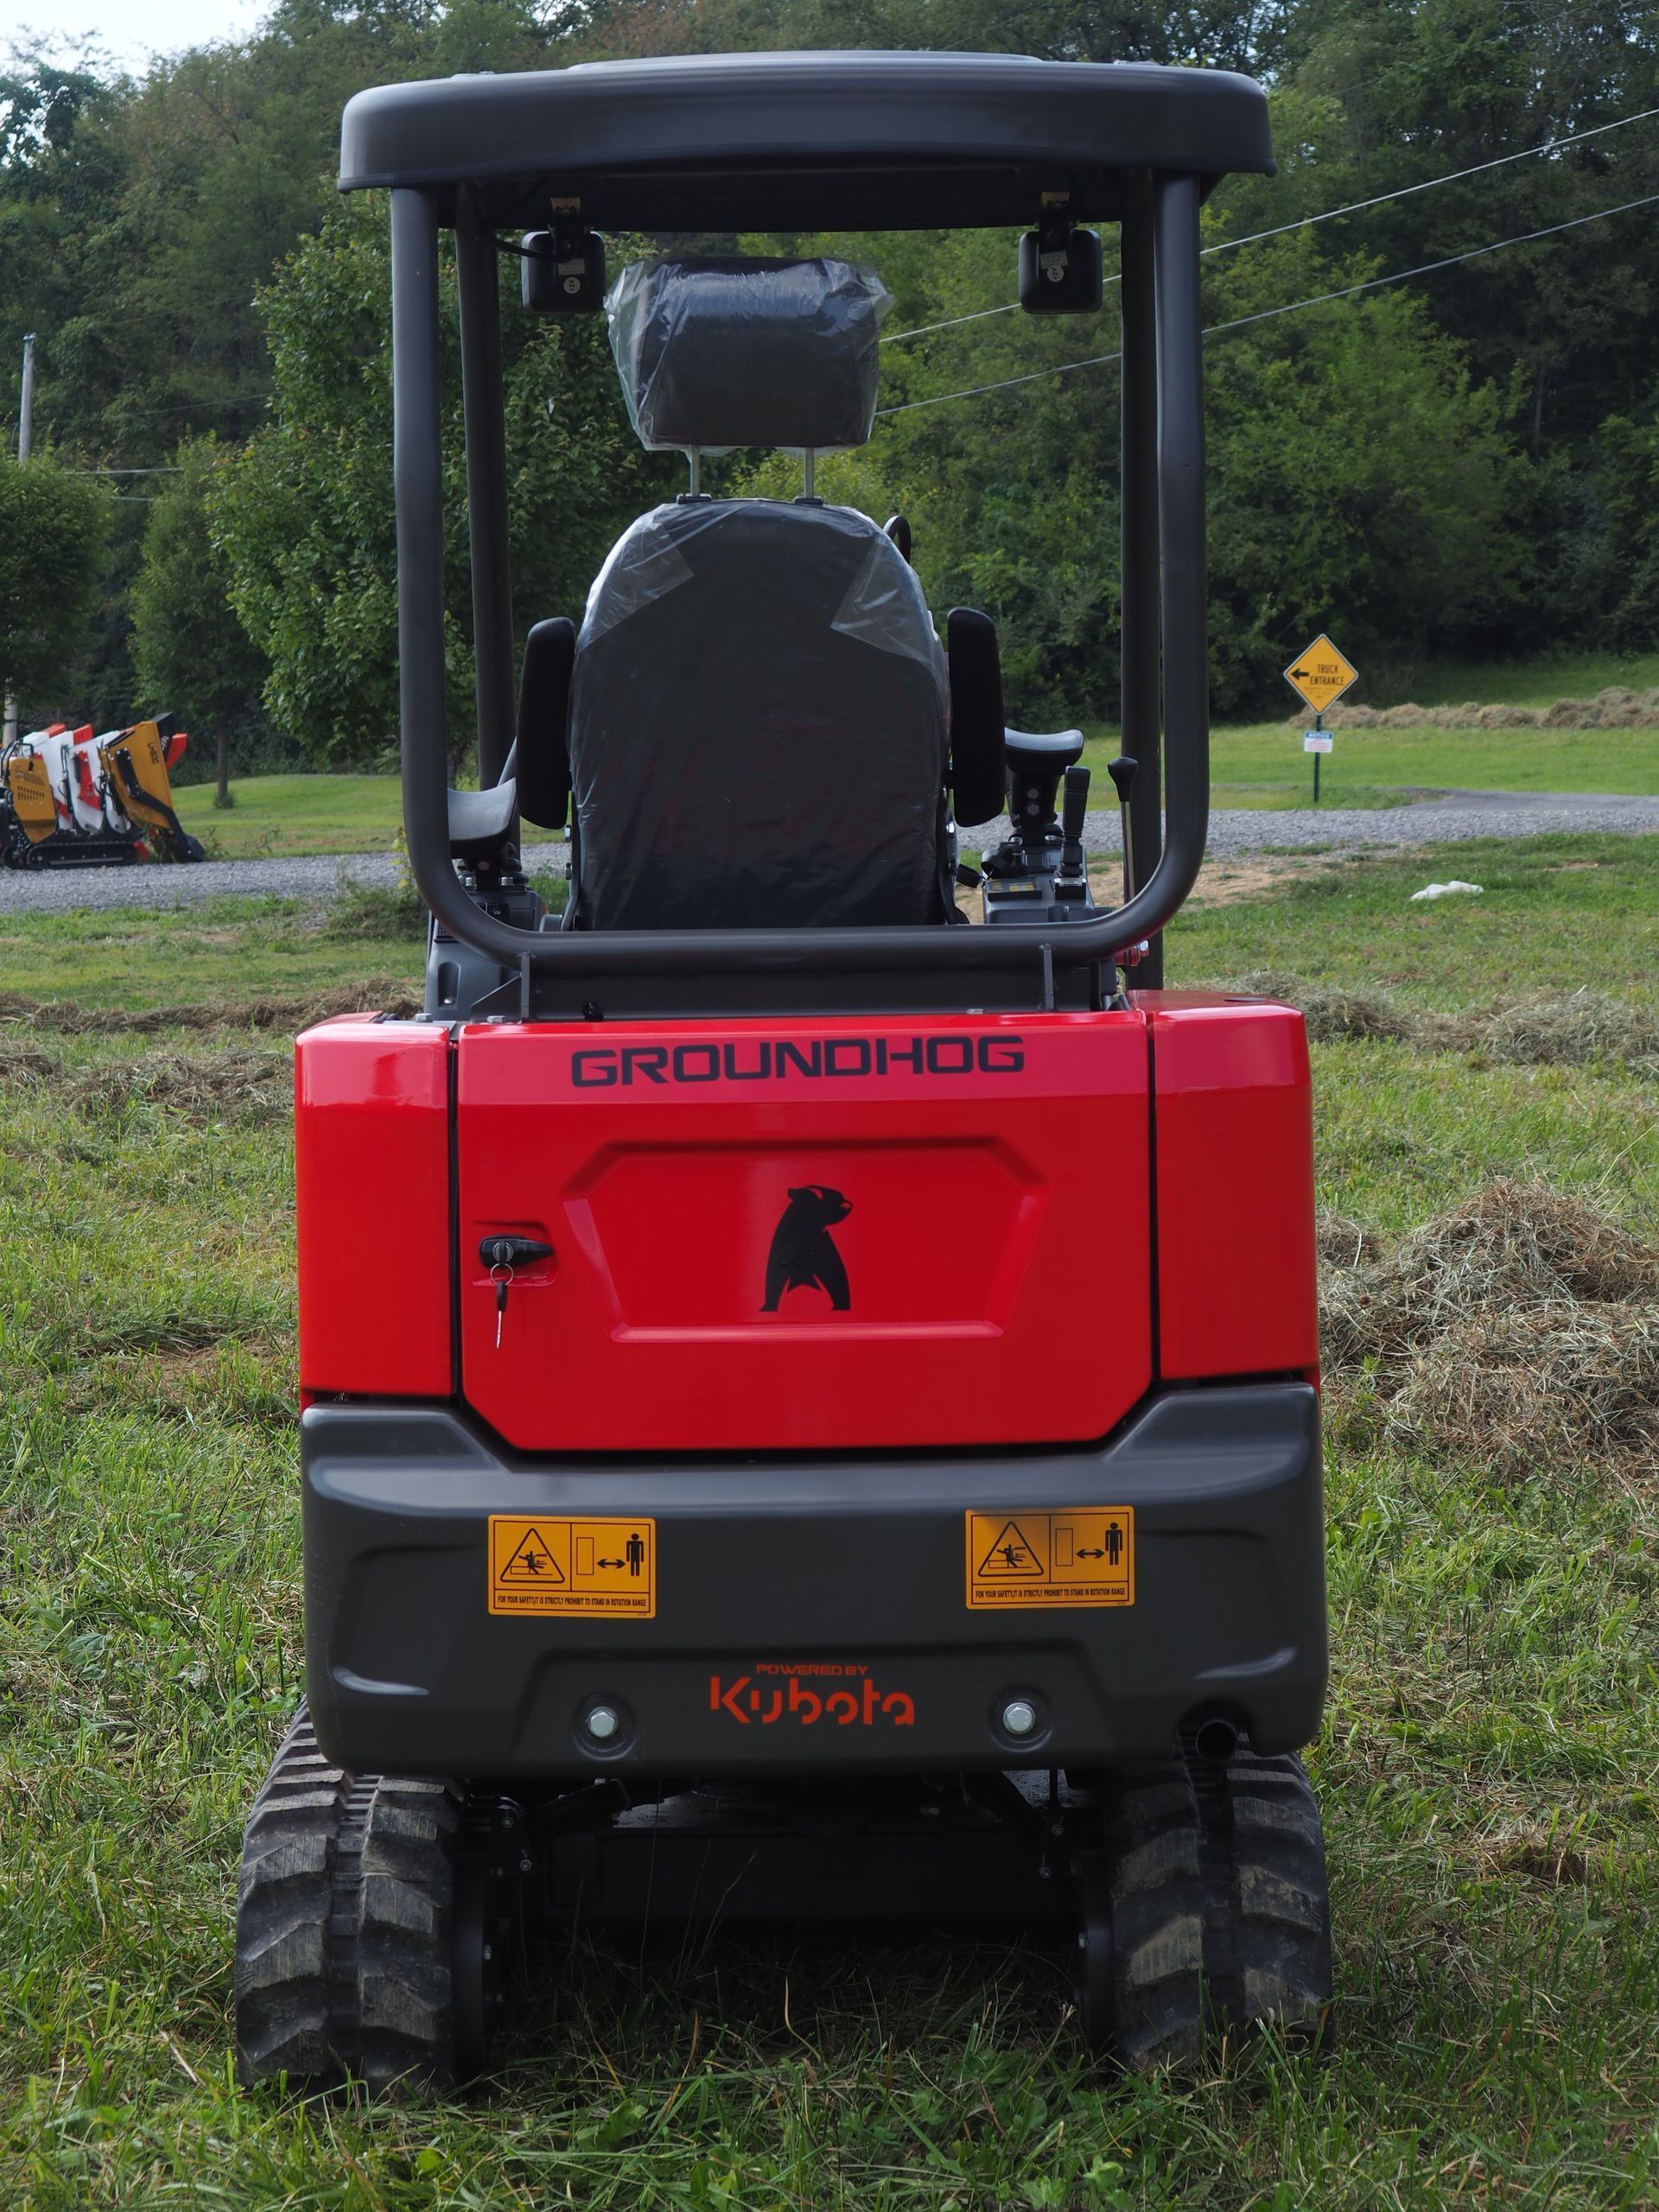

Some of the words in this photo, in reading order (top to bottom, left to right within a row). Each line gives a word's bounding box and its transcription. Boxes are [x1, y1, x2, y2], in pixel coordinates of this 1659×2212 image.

[1317, 664, 1338, 673] TRUCK
[1310, 676, 1345, 686] ENTRANCE
[571, 1035, 1026, 1088] GROUNDHOG
[1024, 1589, 1043, 1598] STRICTLY
[1071, 1588, 1084, 1597] STAND
[1111, 1587, 1126, 1596] RANGE
[584, 1597, 590, 1605] TO
[611, 1598, 632, 1606] ROTATION
[756, 1664, 842, 1676] POWERED
[845, 1666, 869, 1676] BY
[710, 1676, 915, 1726] Kubota
